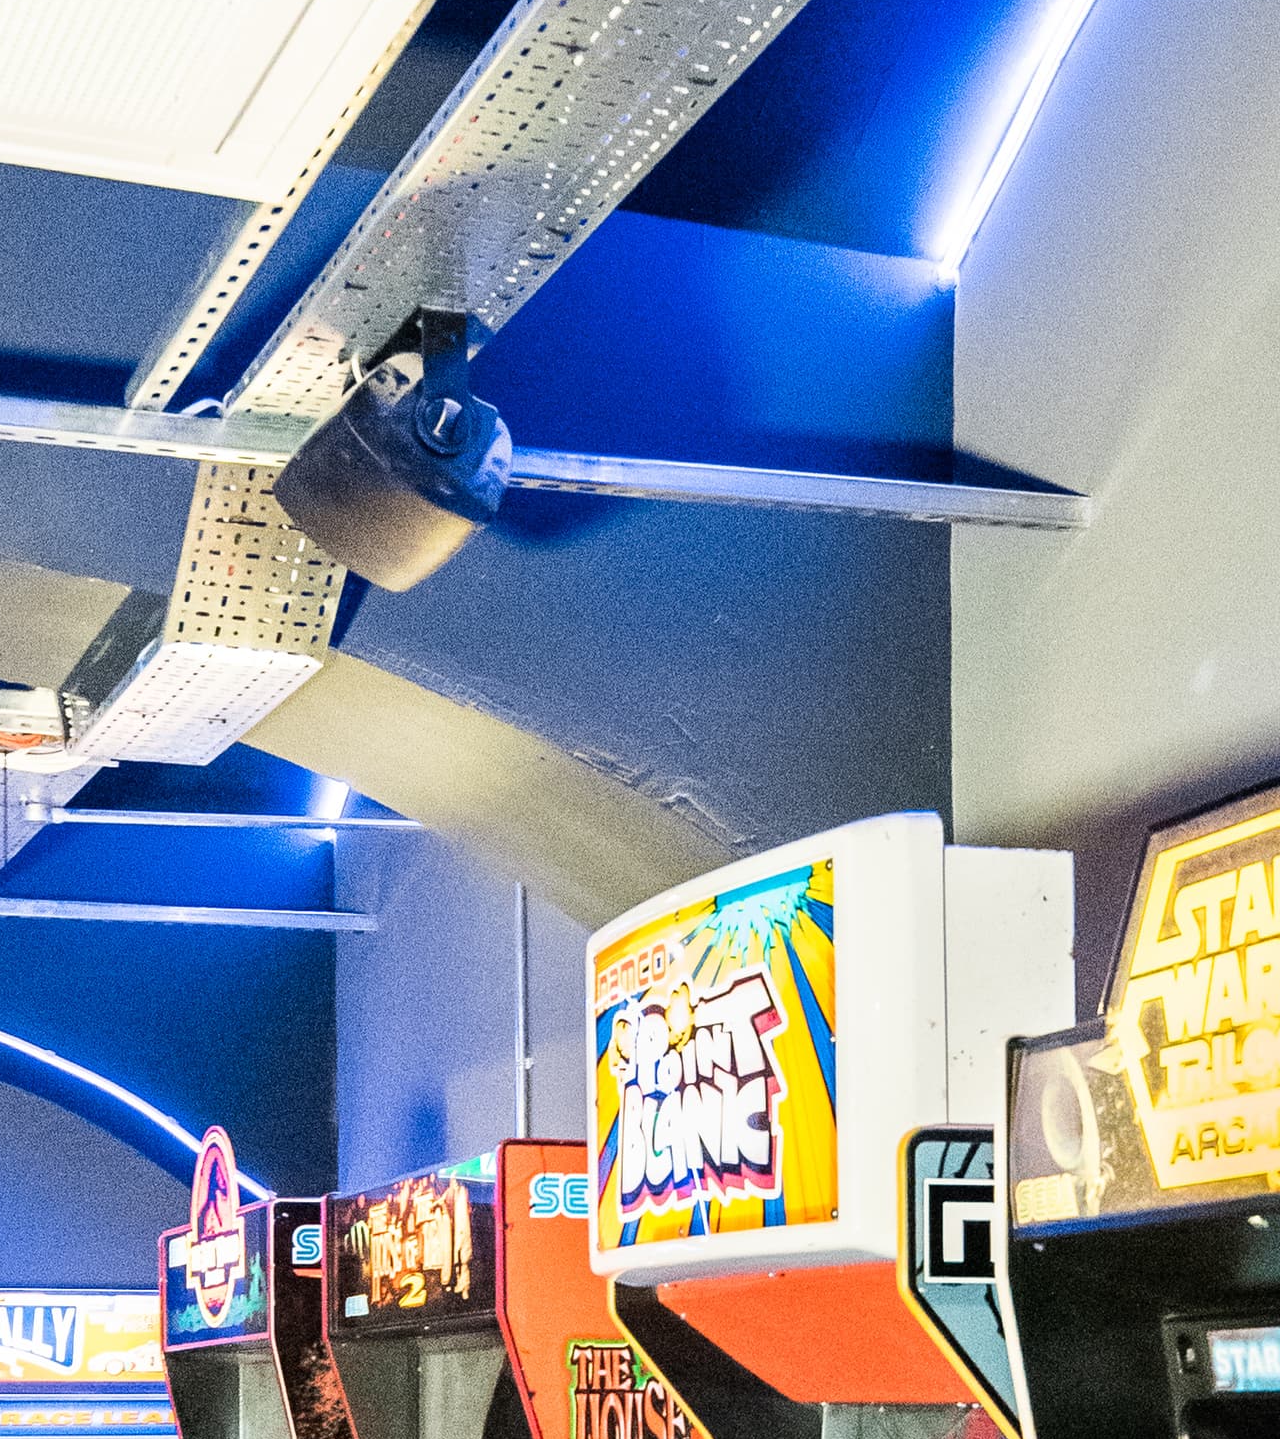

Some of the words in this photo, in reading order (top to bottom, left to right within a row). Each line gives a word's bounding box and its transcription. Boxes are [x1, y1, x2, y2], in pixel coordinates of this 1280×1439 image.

[635, 973, 774, 1092] POINT
[620, 1067, 770, 1194] BLANK
[399, 1272, 426, 1308] 2
[572, 1347, 632, 1391] THE
[0, 1411, 92, 1426] RACE
